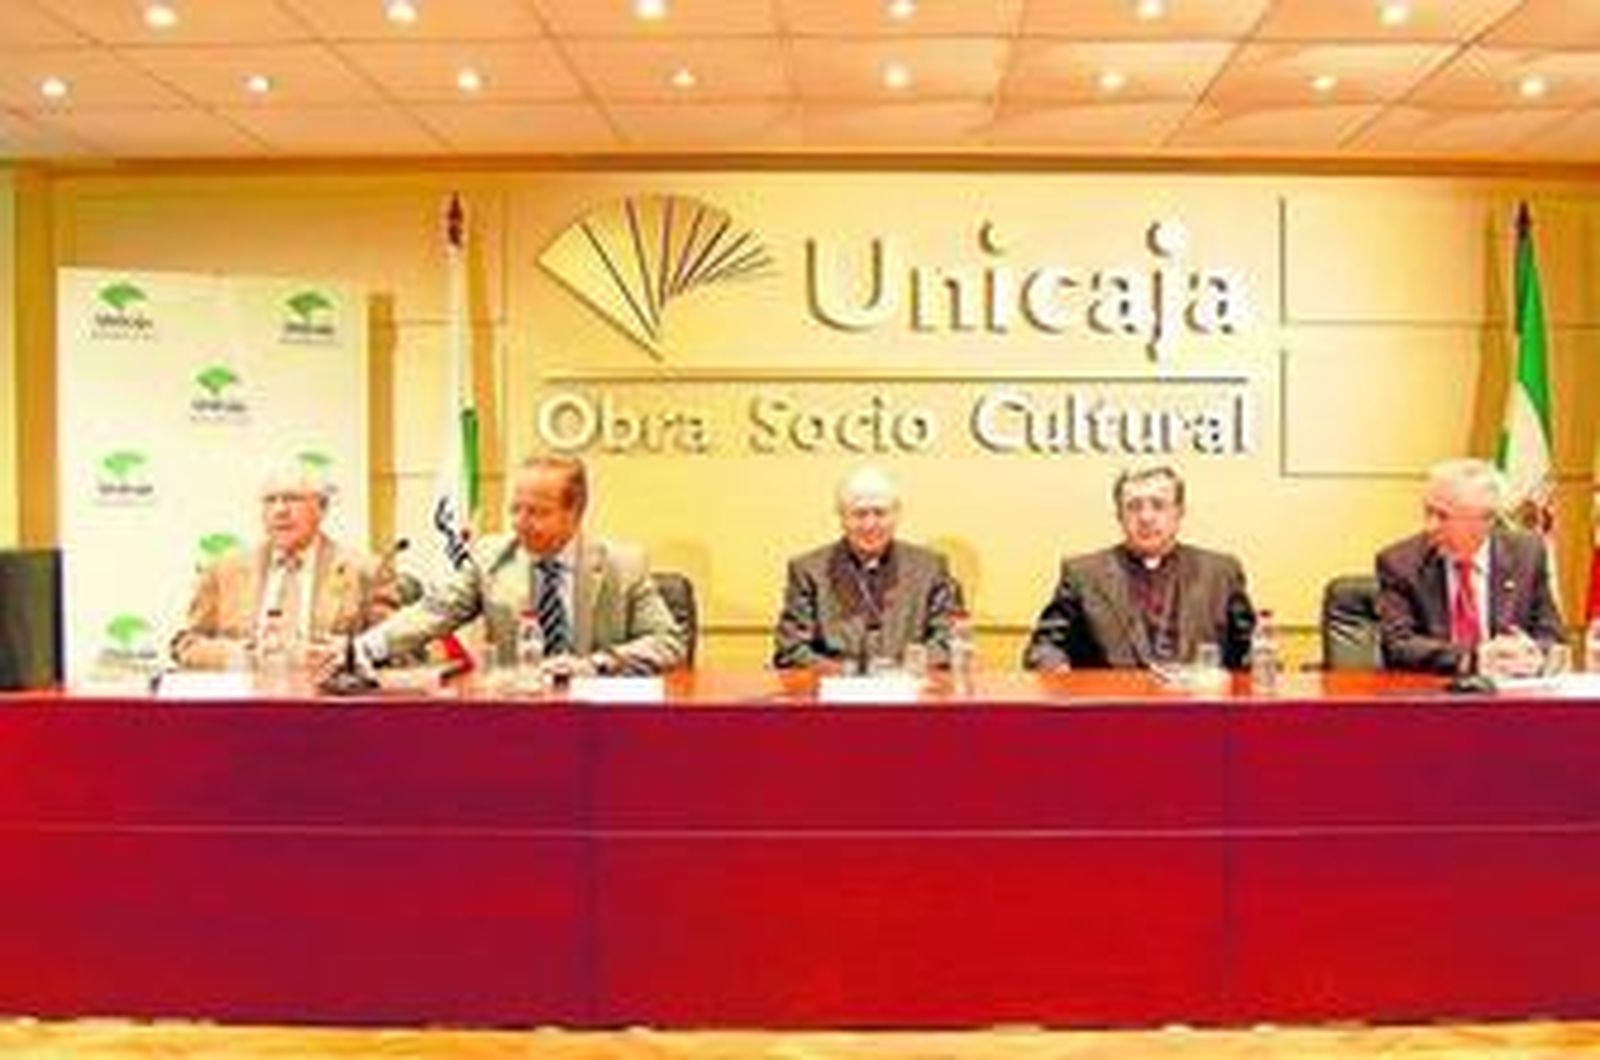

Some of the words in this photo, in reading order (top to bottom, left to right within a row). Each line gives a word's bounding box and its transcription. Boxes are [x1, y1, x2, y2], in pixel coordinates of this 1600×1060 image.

[804, 220, 1242, 363] Unicaja
[536, 392, 709, 455] Obra
[748, 395, 936, 455] Socio
[968, 391, 1250, 455] Cultural
